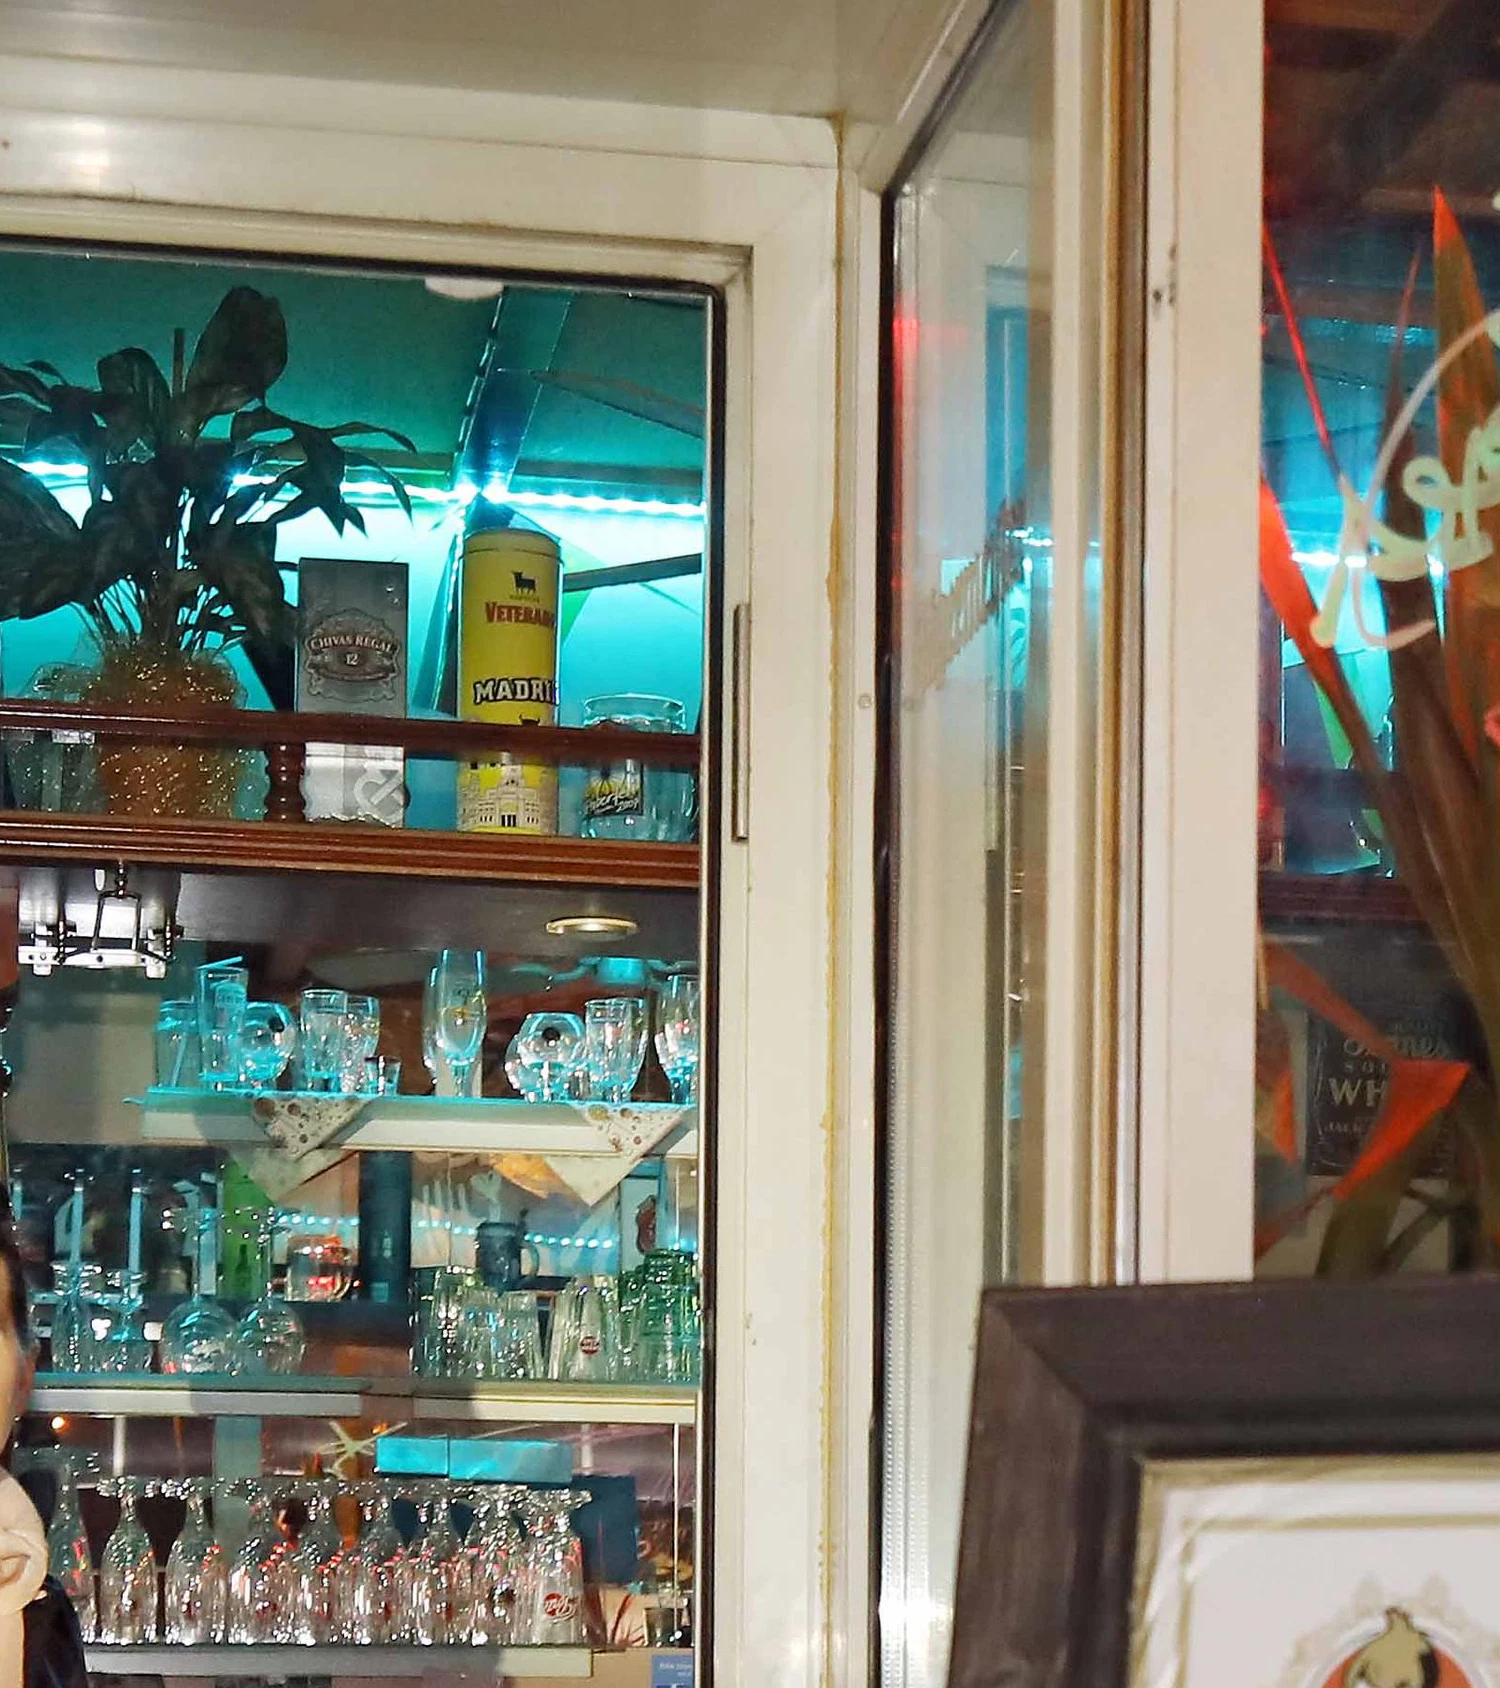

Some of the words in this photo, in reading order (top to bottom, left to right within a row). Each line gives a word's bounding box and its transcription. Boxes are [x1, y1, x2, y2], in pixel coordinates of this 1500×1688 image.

[310, 635, 353, 651] CHIVAS
[355, 635, 394, 653] REGAL
[345, 653, 359, 666] 12
